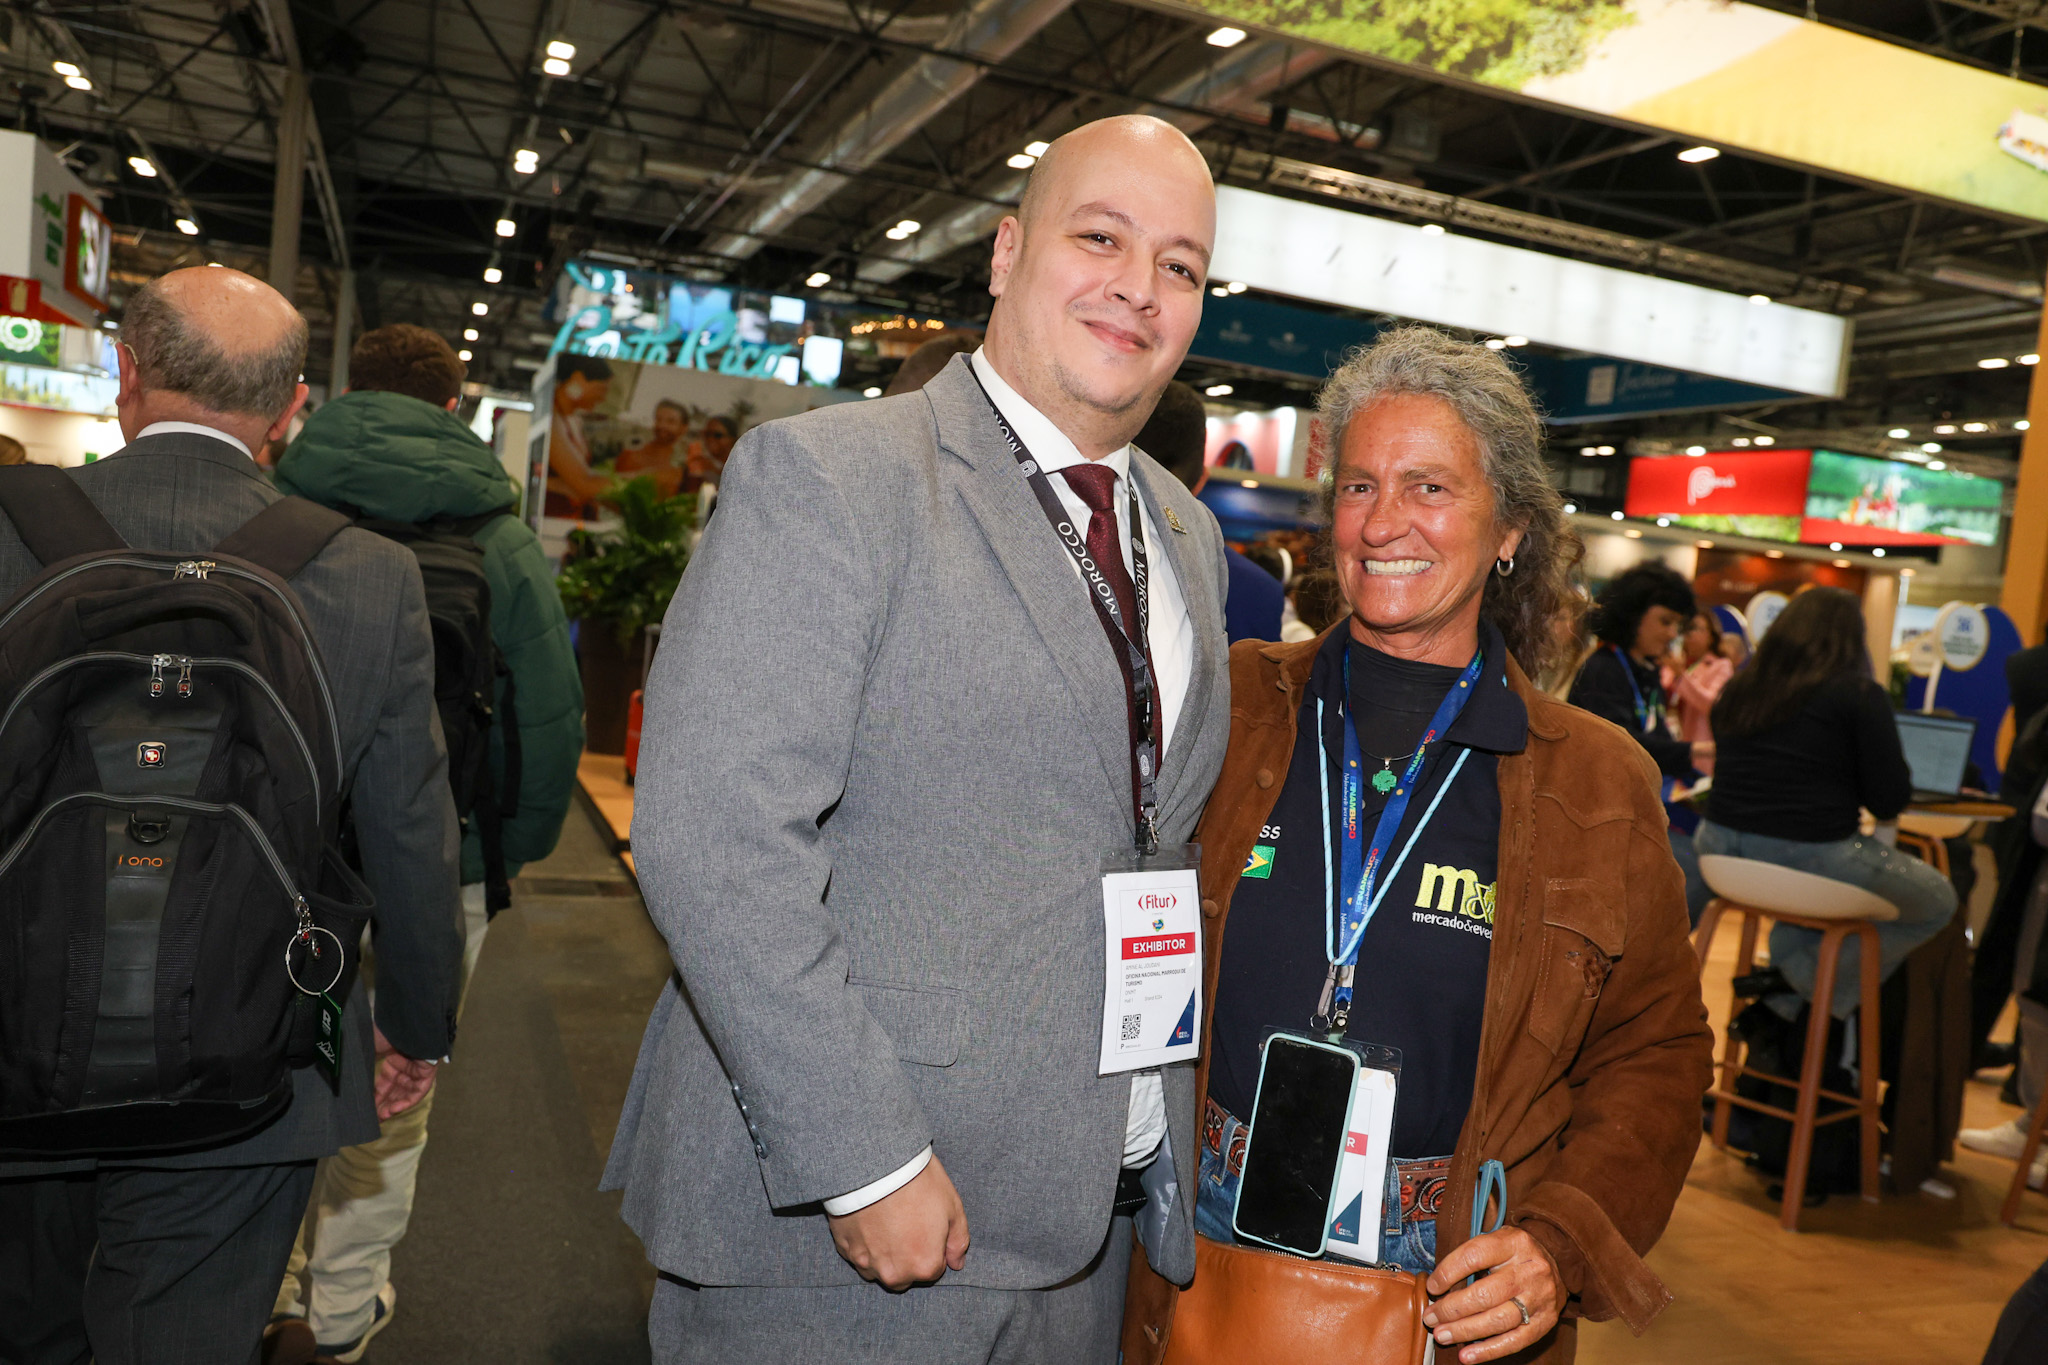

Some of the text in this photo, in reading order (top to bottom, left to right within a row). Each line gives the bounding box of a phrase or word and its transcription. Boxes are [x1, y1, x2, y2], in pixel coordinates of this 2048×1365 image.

[674, 308, 793, 380] Rico
[1058, 521, 1118, 615] MOROCCO
[1145, 894, 1171, 910] Fitur
[1412, 911, 1493, 940] mercado&eve
[1132, 938, 1187, 955] EXHIBITOR
